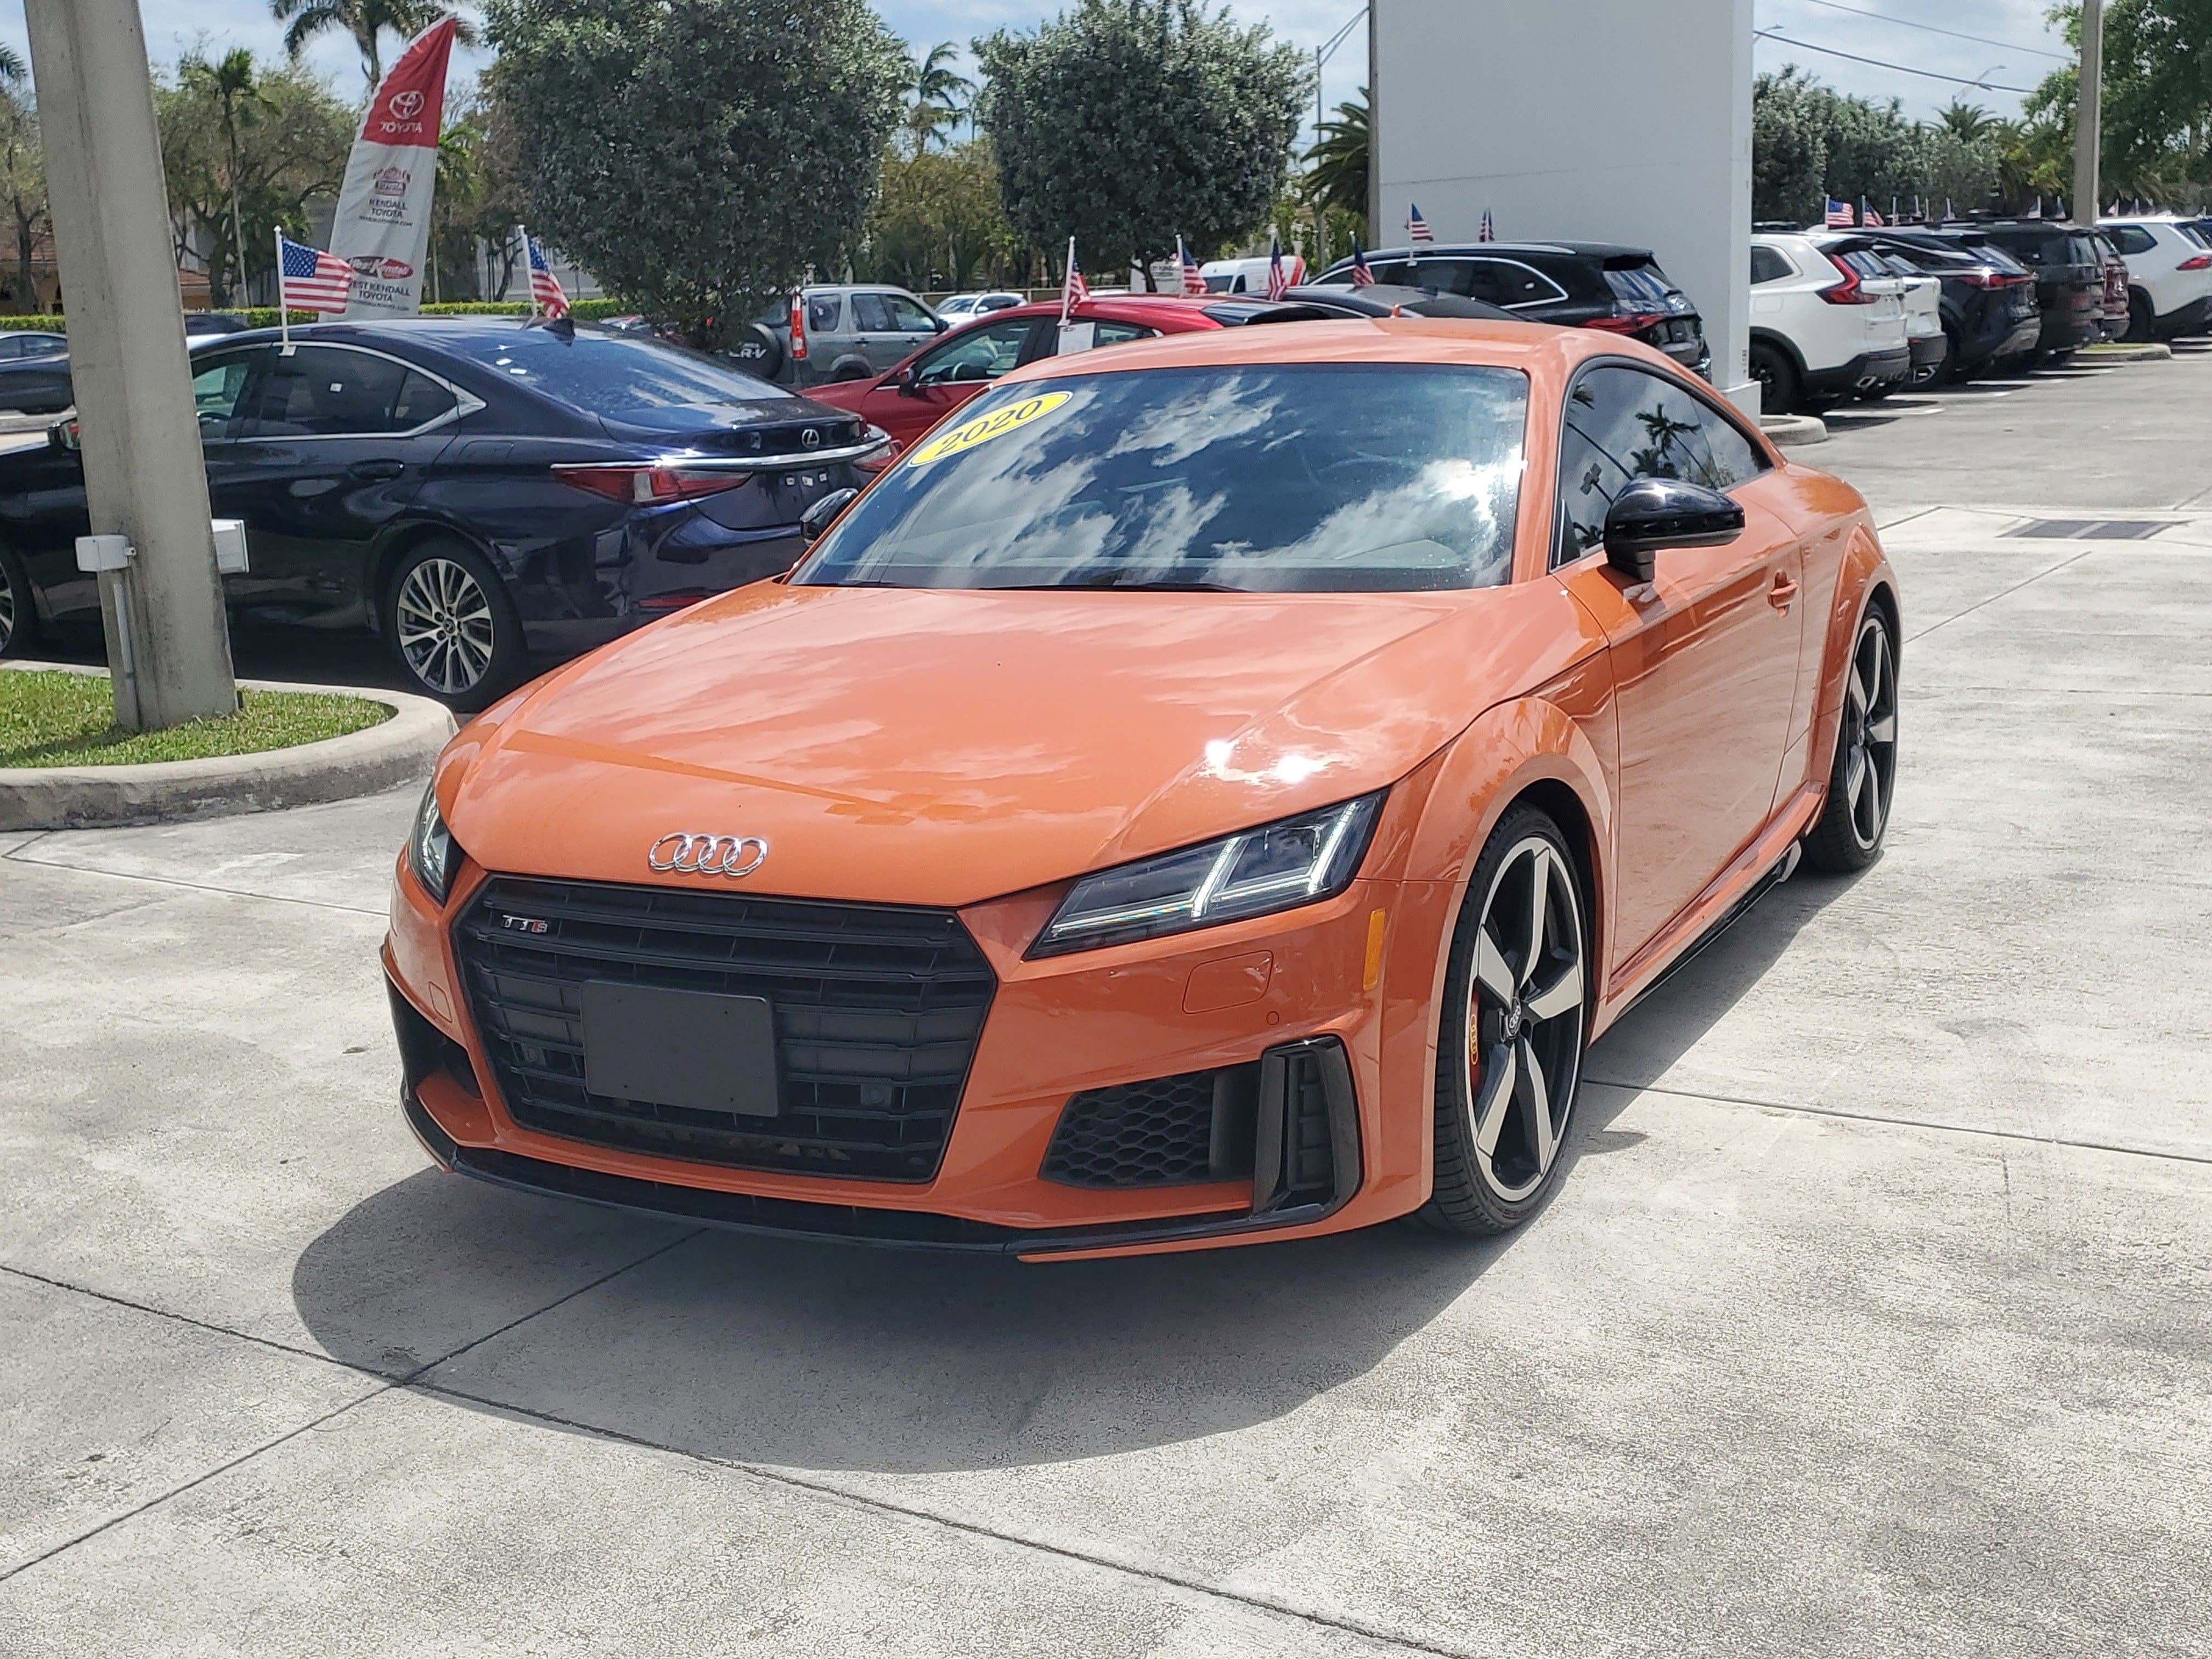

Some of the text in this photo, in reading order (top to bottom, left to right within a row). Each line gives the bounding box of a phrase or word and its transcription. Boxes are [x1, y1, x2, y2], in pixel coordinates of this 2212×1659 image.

[380, 121, 422, 133] TOYOTA
[369, 199, 408, 211] KENDALL
[372, 208, 403, 218] TOYOTA
[369, 283, 411, 296] KENDALL
[359, 290, 392, 302] TOYOTA
[934, 400, 1042, 457] 2020
[503, 915, 548, 933] TTS
